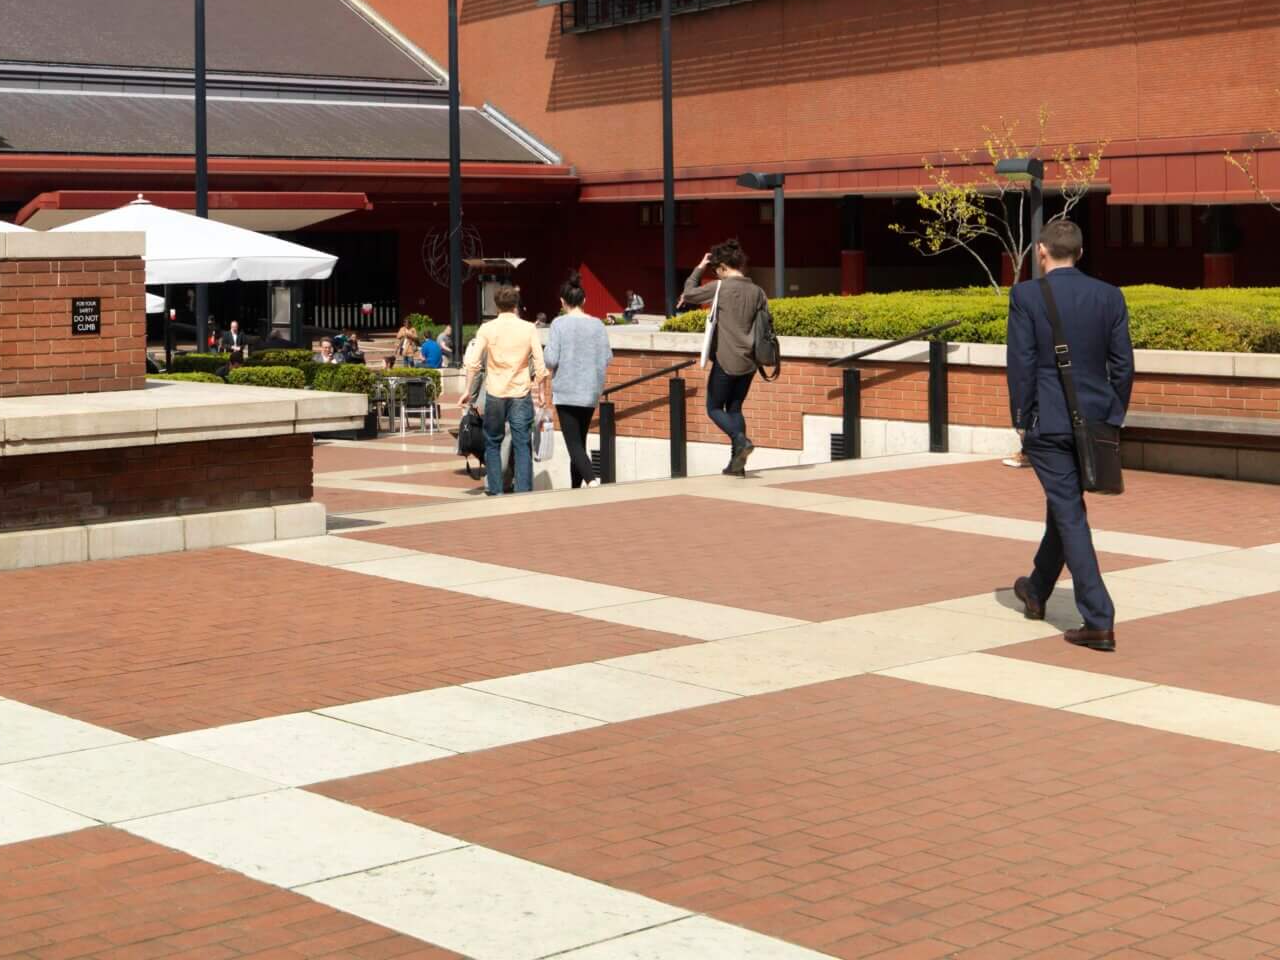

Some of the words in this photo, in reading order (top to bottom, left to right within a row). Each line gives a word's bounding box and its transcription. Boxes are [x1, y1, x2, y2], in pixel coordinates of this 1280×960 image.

[73, 315, 84, 323] DO
[85, 314, 99, 322] NOT
[77, 323, 96, 331] CLIMB
